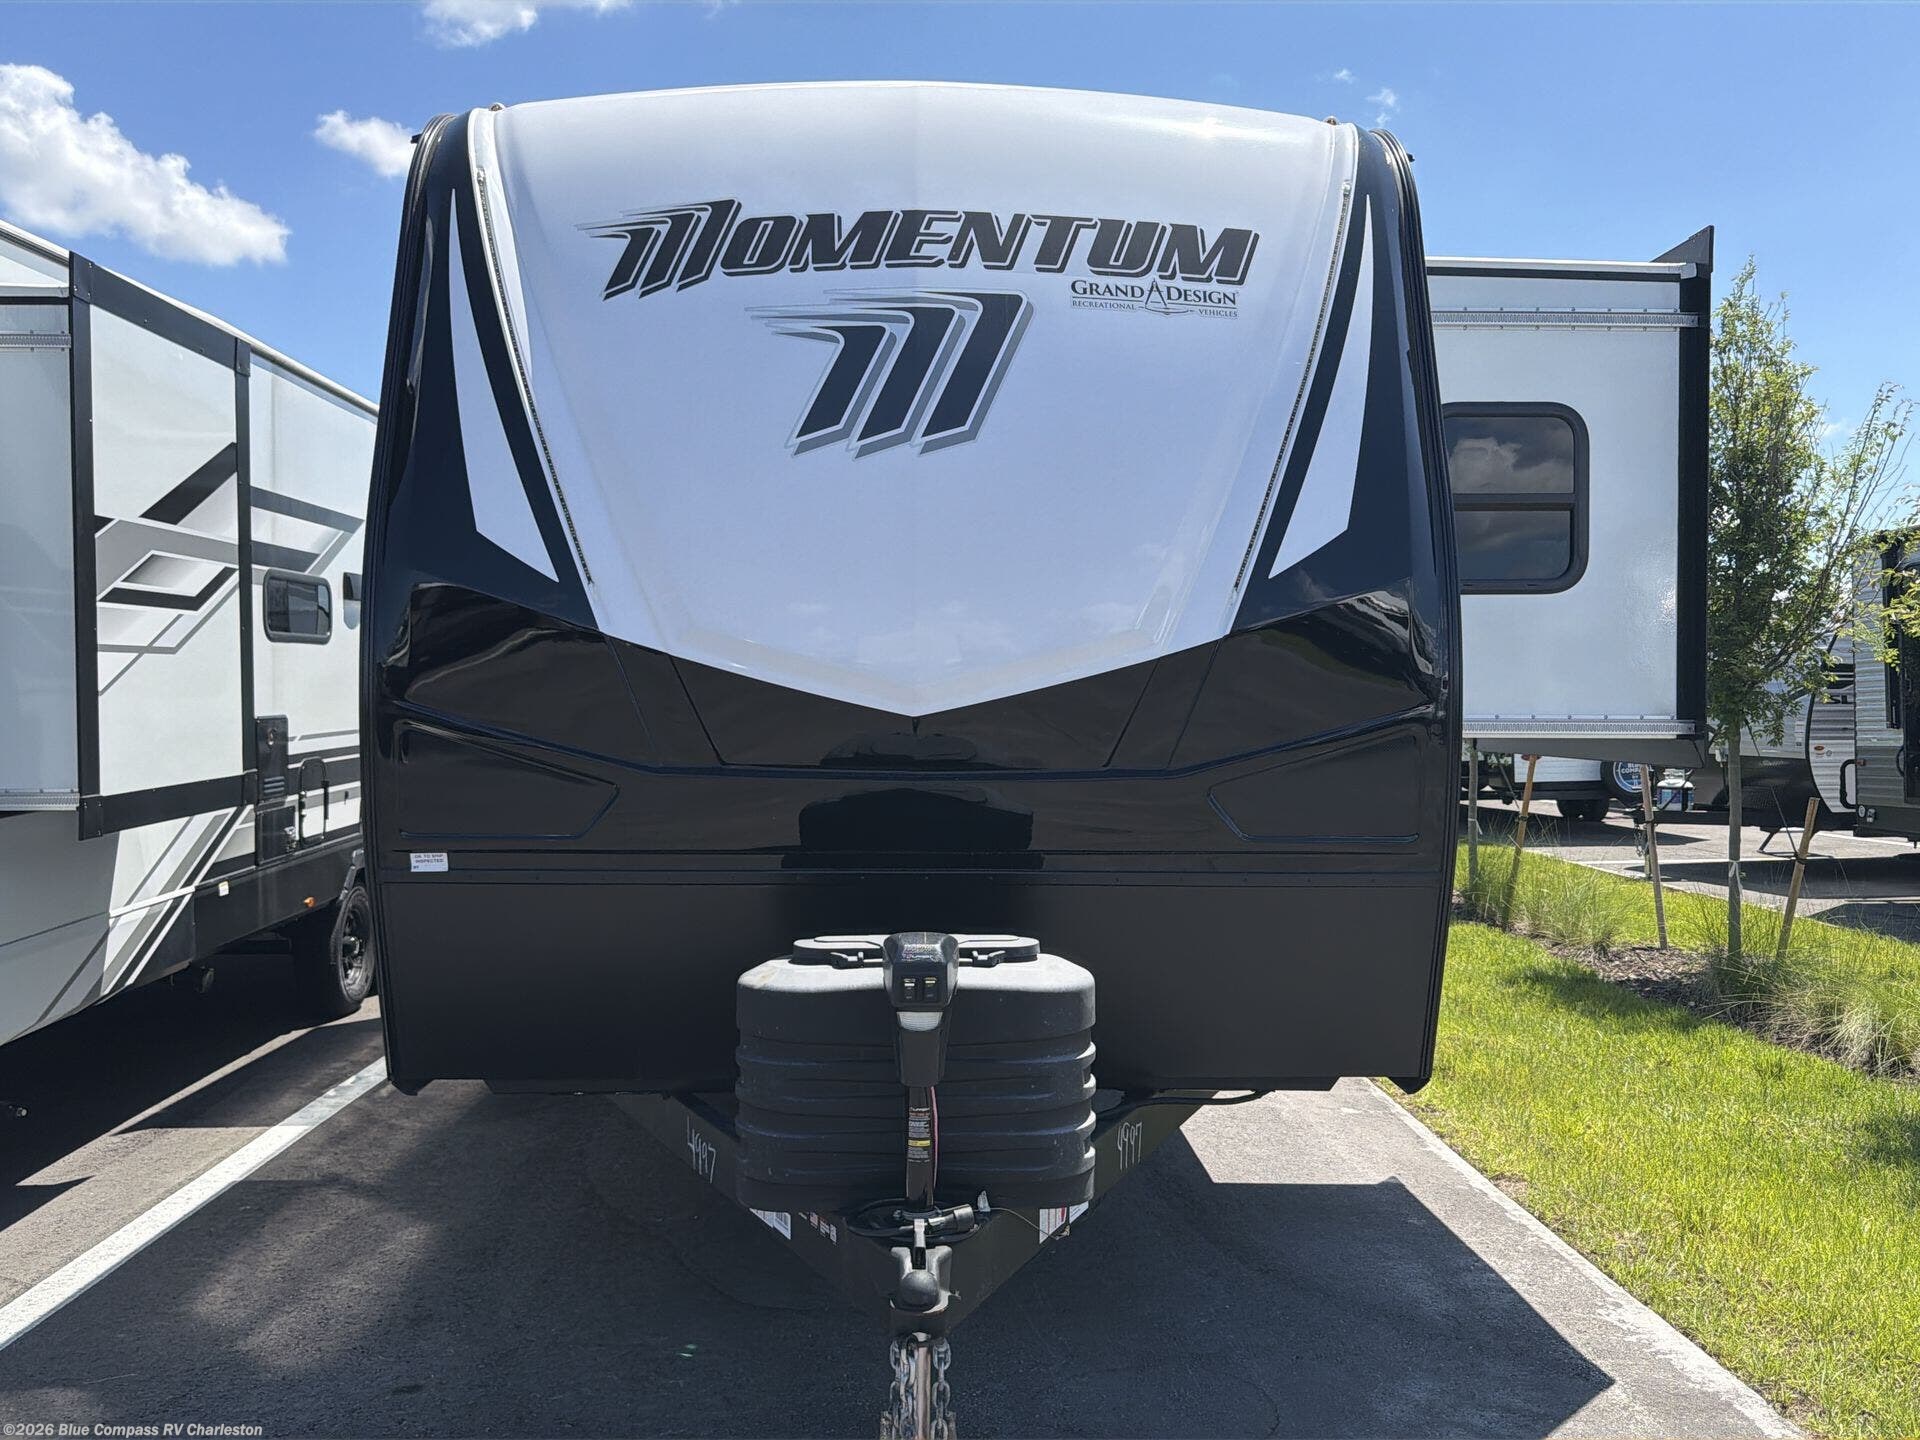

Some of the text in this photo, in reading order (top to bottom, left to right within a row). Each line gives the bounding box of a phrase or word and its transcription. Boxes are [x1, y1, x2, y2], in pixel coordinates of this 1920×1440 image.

[574, 198, 1260, 301] MOMENTUM
[1070, 279, 1237, 306] GRAND DESIGN
[1071, 300, 1238, 318] RECREATIONAL VEHICLES
